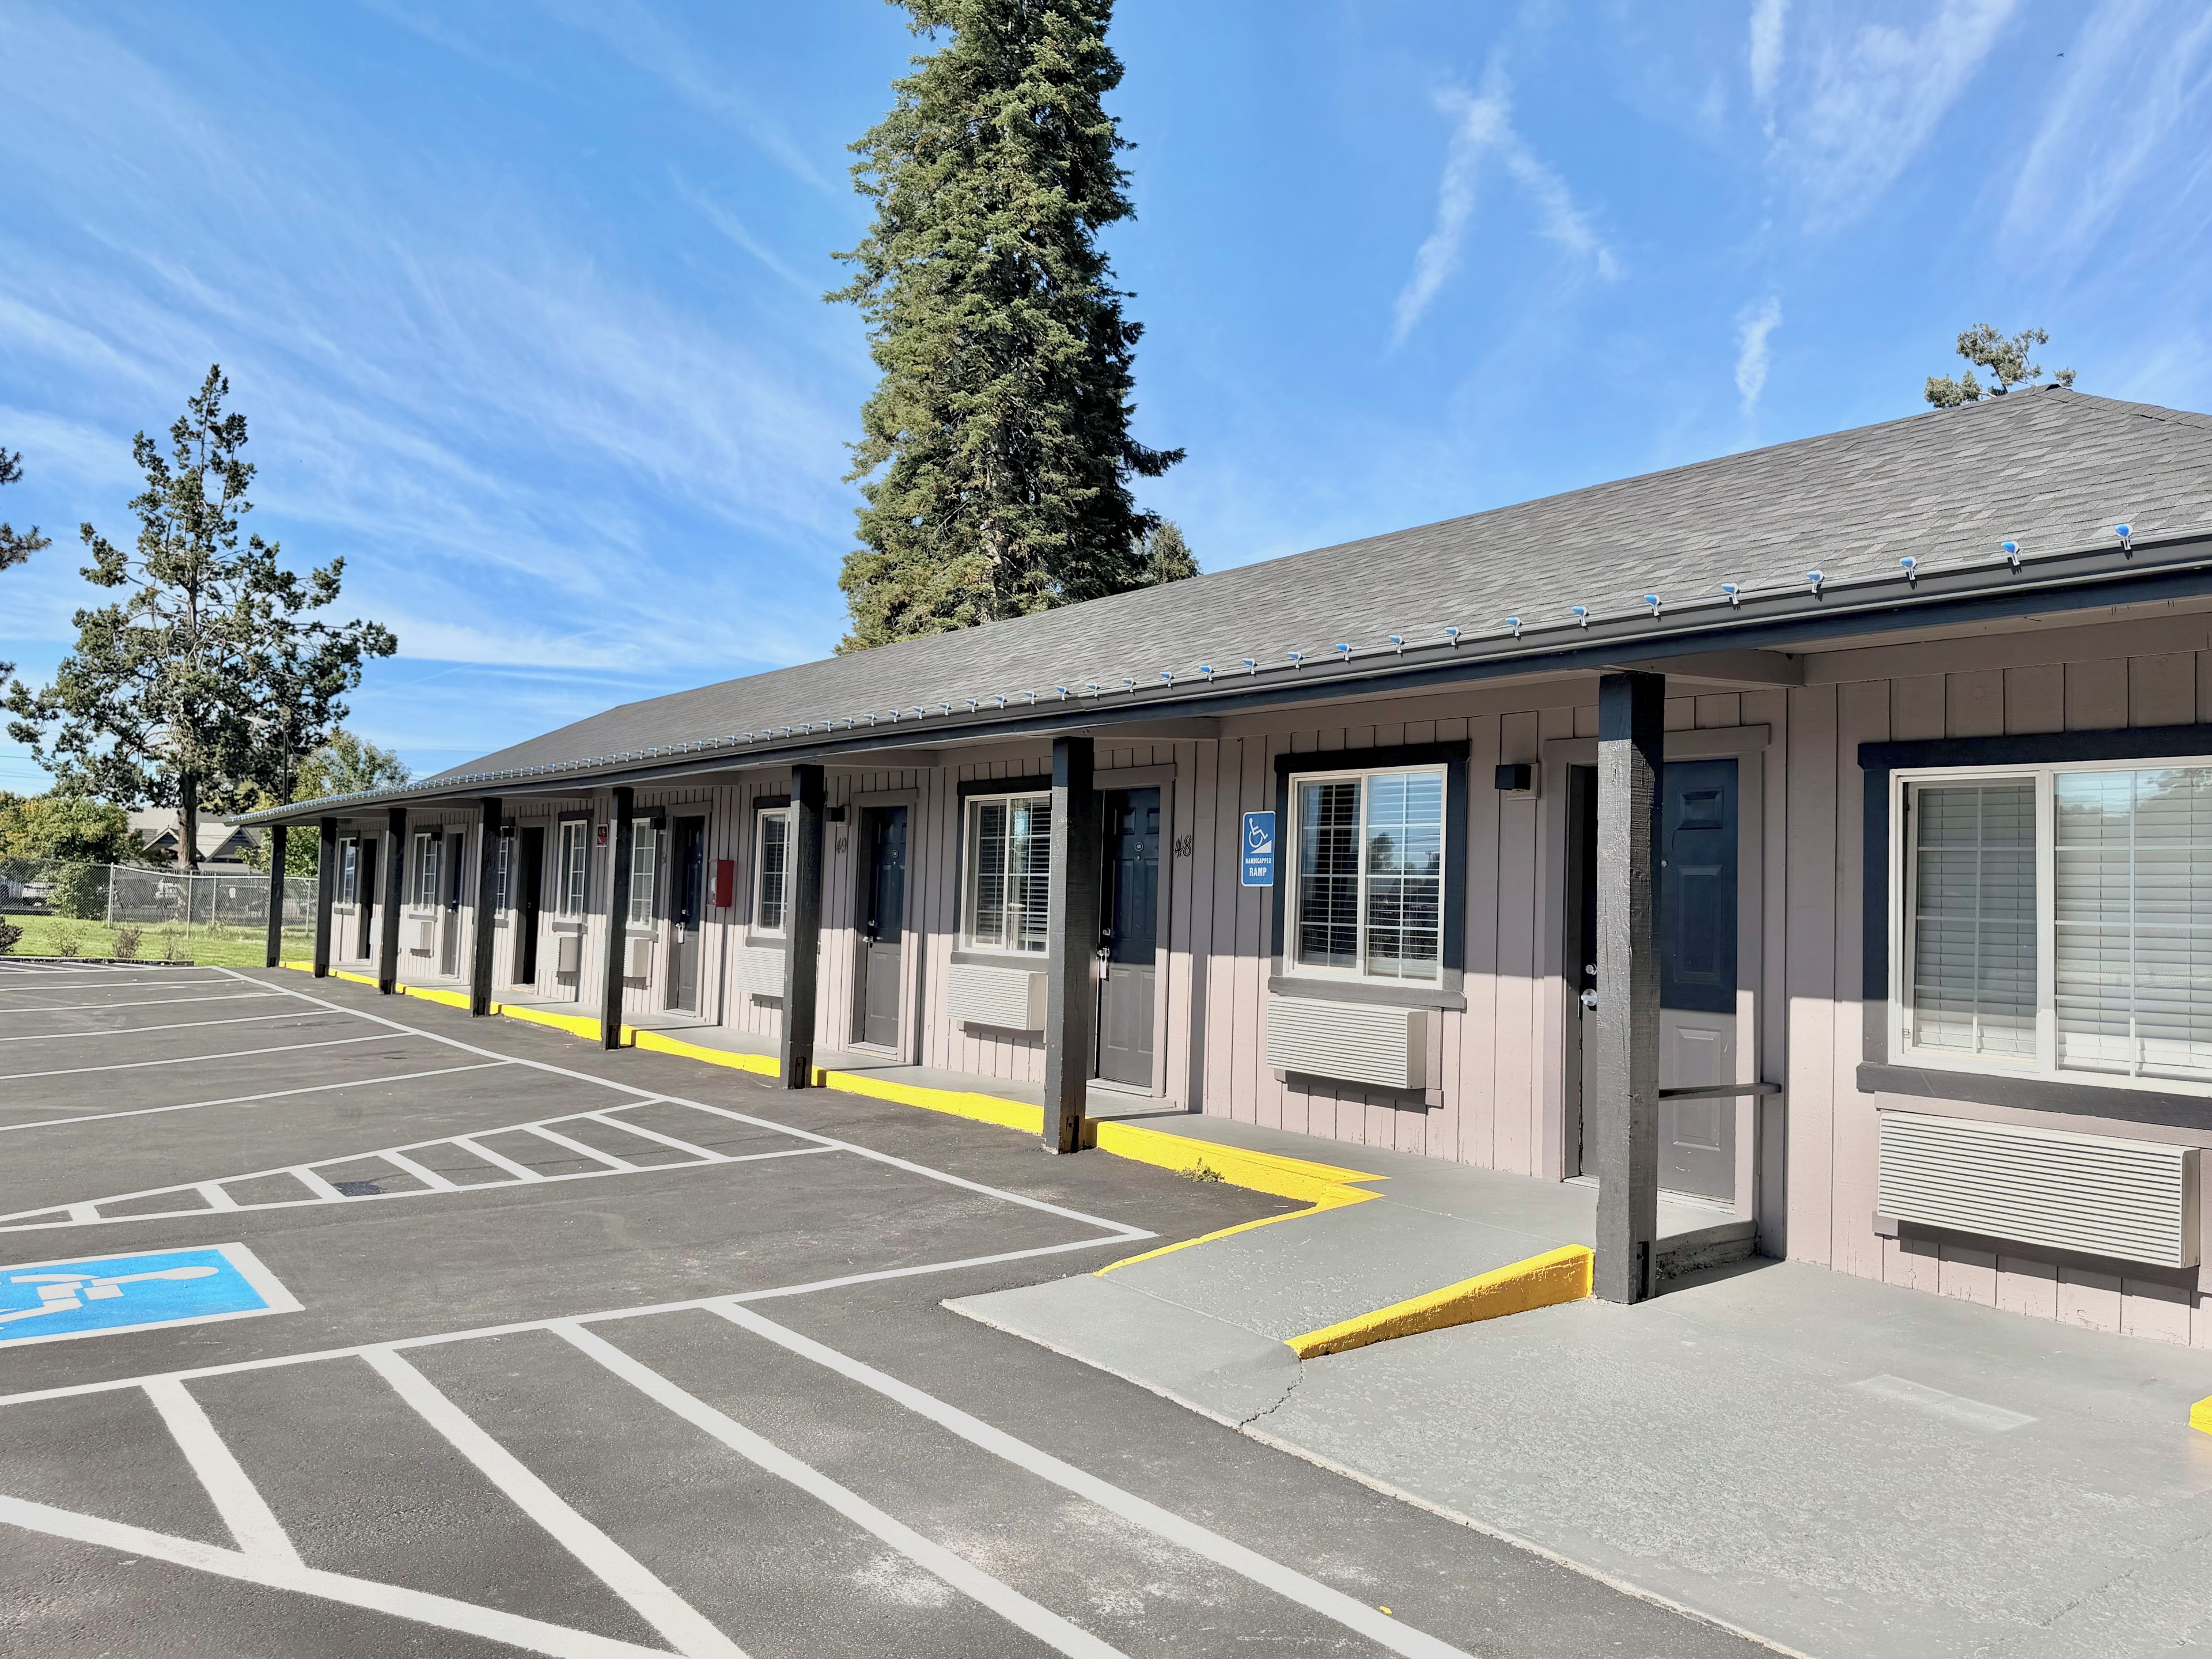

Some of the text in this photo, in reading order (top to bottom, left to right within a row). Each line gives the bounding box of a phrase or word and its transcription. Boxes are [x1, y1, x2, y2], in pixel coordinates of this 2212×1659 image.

[836, 837, 847, 854] 49
[1174, 835, 1192, 858] 48
[1249, 867, 1267, 877] RAMP
